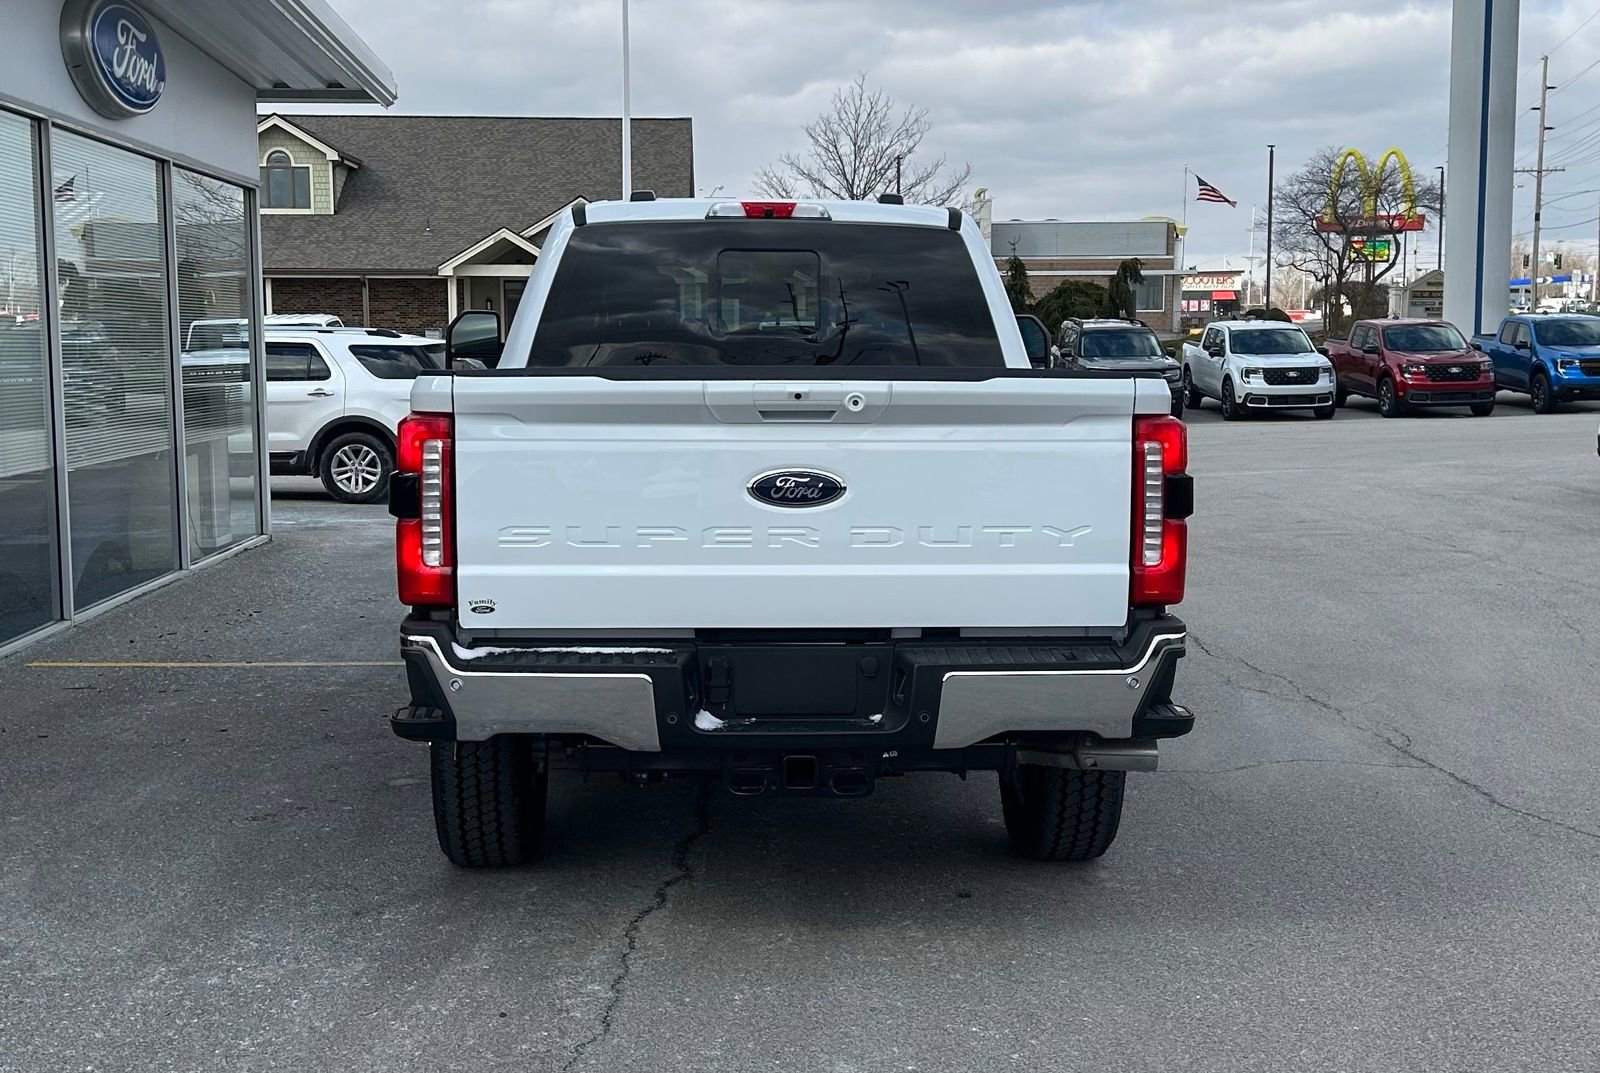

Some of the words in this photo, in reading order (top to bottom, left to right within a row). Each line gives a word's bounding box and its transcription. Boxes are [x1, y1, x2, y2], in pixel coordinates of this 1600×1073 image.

[112, 18, 158, 93] Ford
[770, 476, 824, 499] Ford
[499, 525, 820, 547] SUPER
[850, 525, 1092, 547] DUTY
